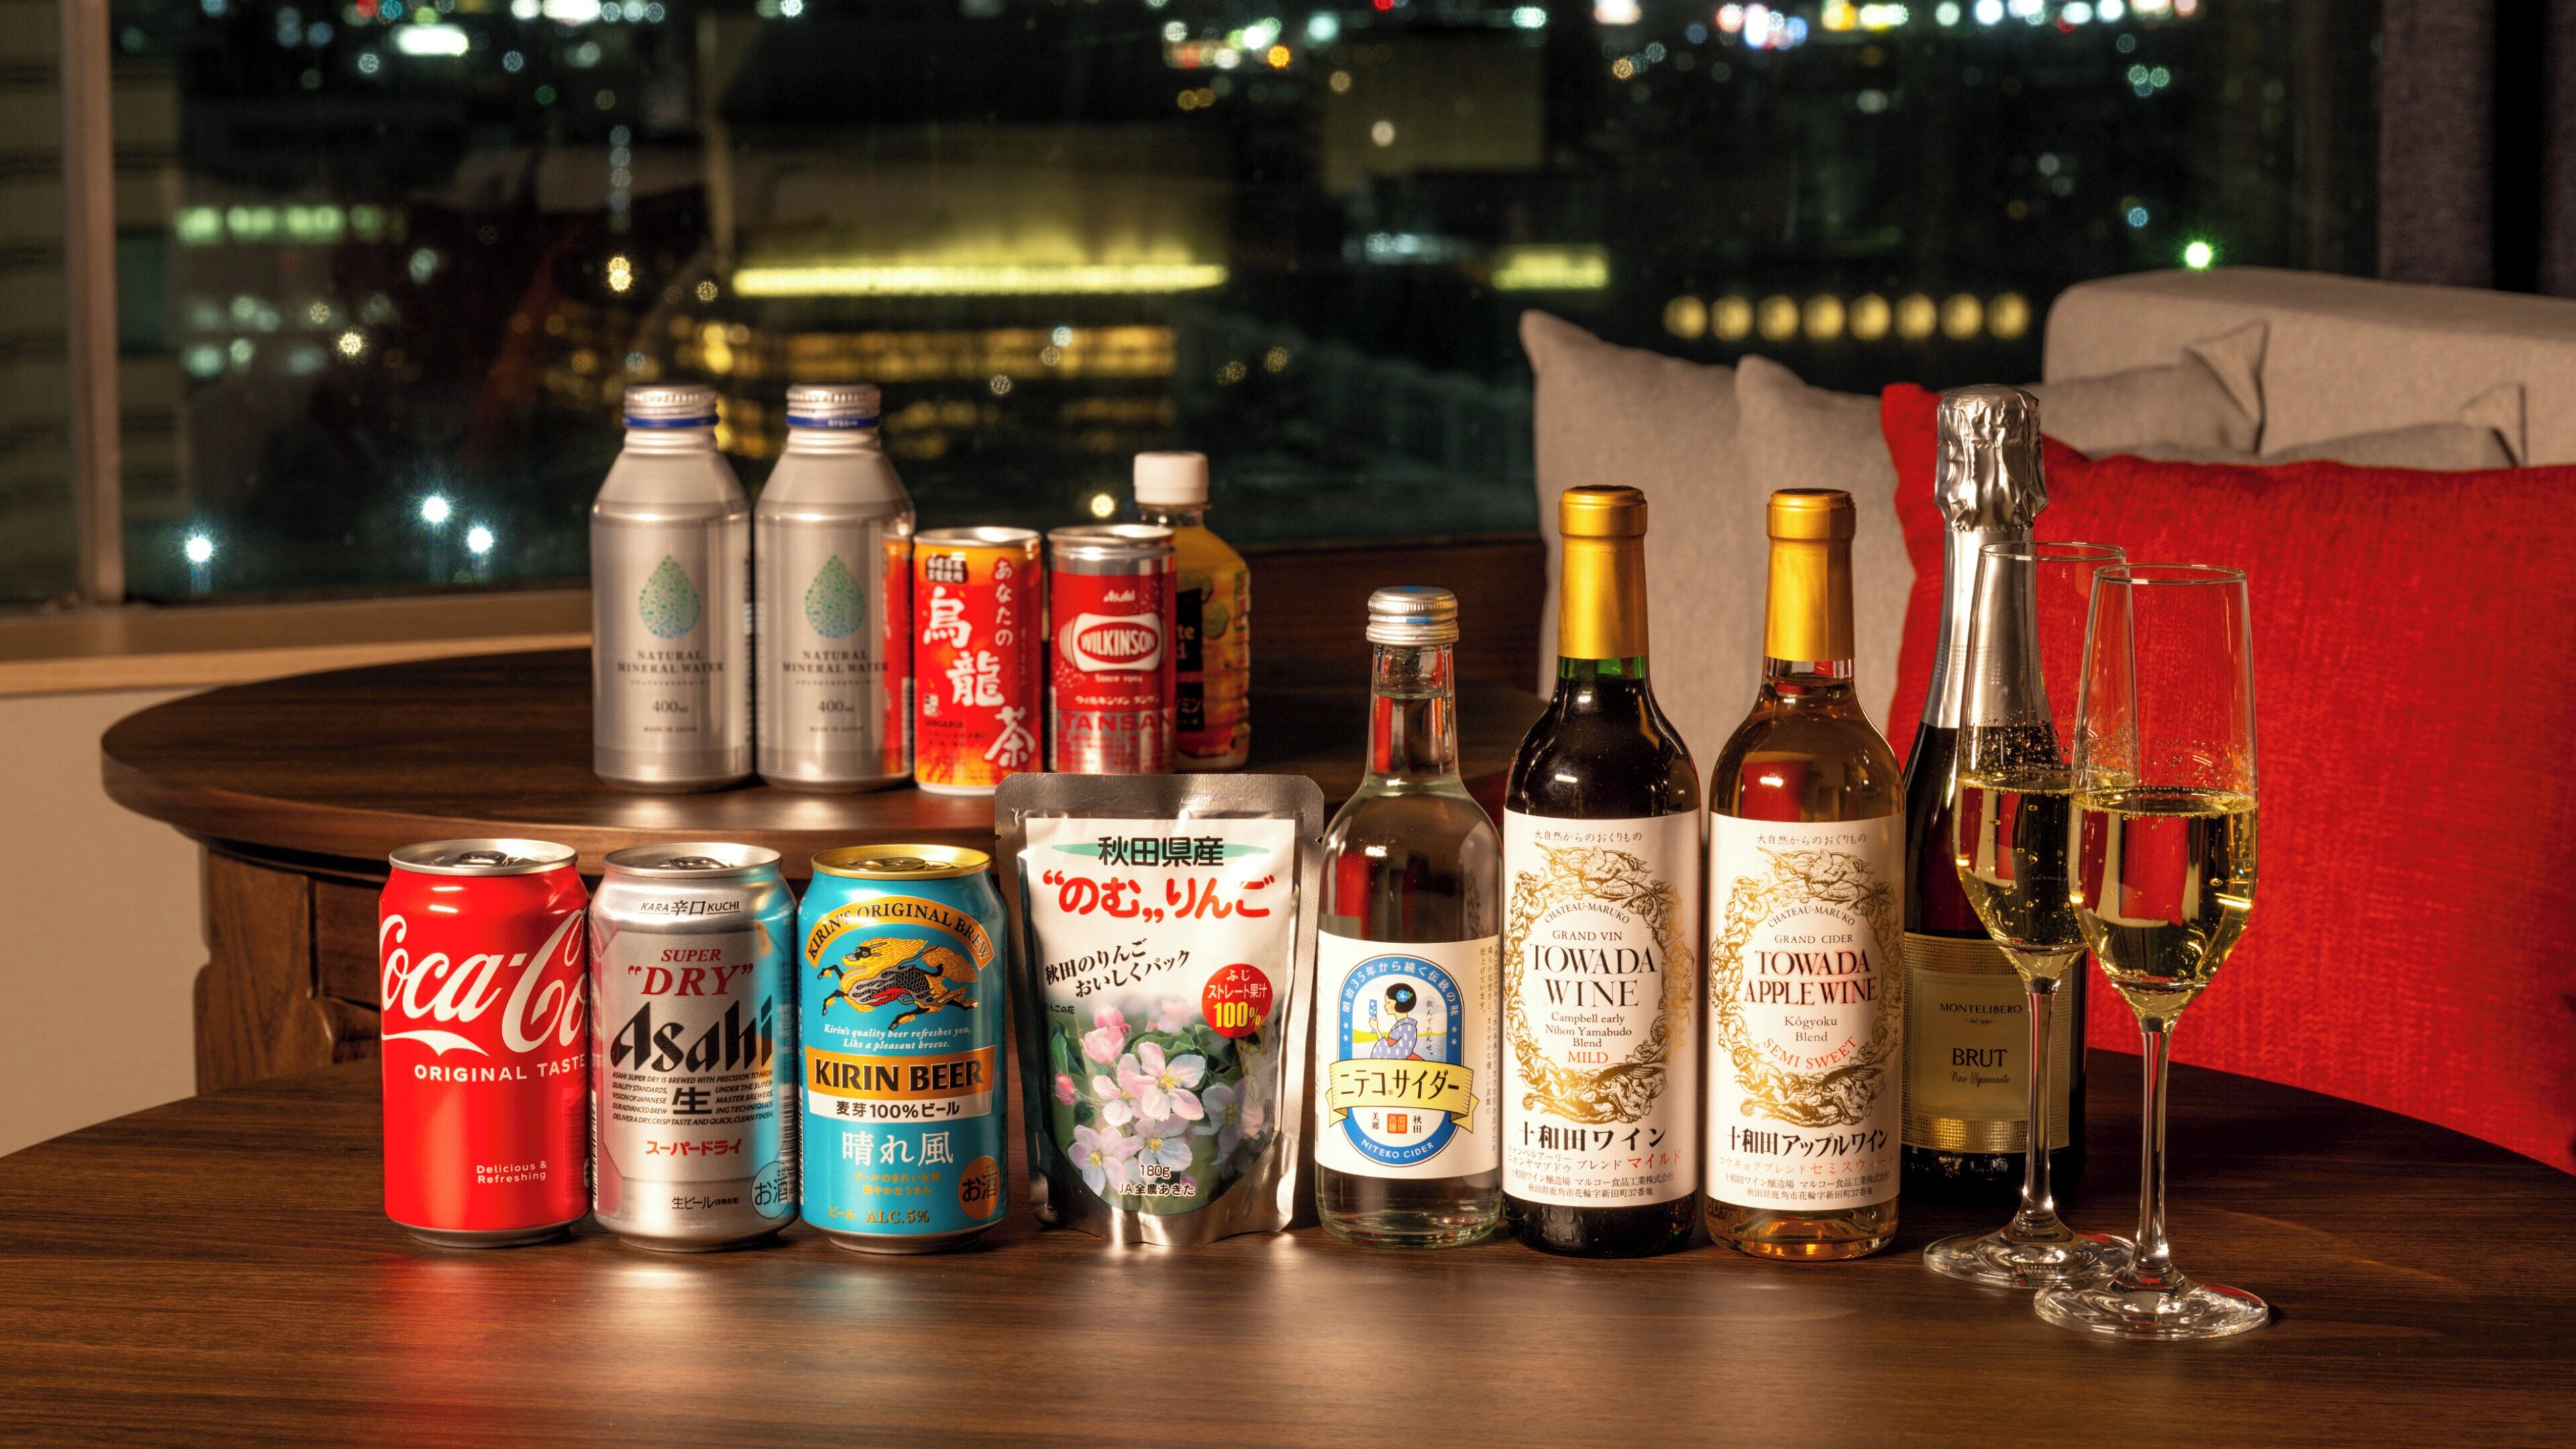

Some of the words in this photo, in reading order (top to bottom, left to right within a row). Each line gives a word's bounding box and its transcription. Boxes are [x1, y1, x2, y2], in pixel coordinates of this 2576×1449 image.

[994, 559, 1014, 647] あなたの
[1103, 590, 1136, 602] Asahi
[1079, 628, 1156, 657] WILKINSON
[638, 650, 702, 661] NATURAL
[803, 650, 869, 661] NATURAL
[618, 661, 678, 673] MINERAL
[682, 661, 724, 672] WATER
[782, 661, 843, 673] MINERAL
[847, 661, 889, 672] WATER
[923, 586, 1036, 767] 烏龍茶
[1534, 830, 1643, 843] 大自然からのおくりもの
[1756, 833, 1867, 845] 大自然からのおくりもの
[1097, 836, 1224, 867] 秋田県産
[640, 902, 669, 913] KARA
[671, 900, 706, 916] 辛口
[707, 901, 739, 912] KUCHI
[1544, 902, 1630, 924] CHATEAU-MARUKO
[1768, 906, 1856, 928] CHATEAU-MARUKO
[857, 902, 953, 926] ORIGINAL
[953, 919, 991, 959] BREW
[1552, 930, 1597, 941] GRAND
[1600, 931, 1623, 941] VIN
[1774, 934, 1815, 945] GRAND
[1821, 934, 1854, 944] CIDER
[661, 949, 722, 962] SUPER
[1044, 938, 1147, 986] 秋田のりんご
[1529, 943, 1658, 975] TOWADA
[1755, 949, 1872, 976] TOWADA
[380, 909, 588, 1053] Coca-Co
[1075, 950, 1191, 998] おいしくパック
[1226, 969, 1251, 981] ふじ
[1208, 983, 1268, 1000] ストレート果汁
[1543, 977, 1640, 1008] WINE
[1744, 980, 1815, 1006] APPLE
[1819, 977, 1878, 1005] WINE
[1213, 1002, 1261, 1028] 100%
[1939, 1002, 2023, 1014] MONTELIBERO
[1552, 1012, 1598, 1025] Campbell
[1601, 1014, 1625, 1025] early
[1784, 1016, 1837, 1029] Kôgyoku
[610, 995, 773, 1072] Asahi
[851, 1028, 886, 1040] quality
[888, 1030, 908, 1038] beer
[911, 1026, 951, 1040] refreshes
[1546, 1024, 1575, 1036] Nihon
[1578, 1026, 1632, 1037] Yamabudo
[1795, 1032, 1828, 1042] Blend
[843, 1038, 863, 1048] Like
[873, 1040, 915, 1051] pleasant
[918, 1039, 950, 1049] breeze.
[1572, 1038, 1602, 1048] Blend
[1568, 1051, 1609, 1064] MILD
[1764, 1038, 1799, 1068] SEMI
[1806, 1036, 1857, 1069] SWEET
[1952, 1048, 2008, 1067] BRUT
[415, 1064, 527, 1082] ORIGINAL
[537, 1053, 586, 1077] TASTE
[815, 1058, 899, 1091] KIRIN
[909, 1059, 983, 1091] BEER
[628, 1073, 646, 1081] SUPER
[716, 1073, 749, 1083] PRECISION
[759, 1069, 773, 1077] HIGH
[1950, 1071, 1968, 1083] Vino
[1970, 1071, 2010, 1087] Spumante
[612, 1081, 633, 1090] QUALITY
[715, 1084, 741, 1093] UNDER
[612, 1091, 629, 1101] VISION
[637, 1095, 667, 1104] JAPANESE
[715, 1095, 745, 1104] MASTER
[672, 1087, 712, 1114] 生
[623, 1104, 649, 1113] ADVANCED
[731, 1101, 773, 1112] TECHNIQUES
[837, 1100, 960, 1119] 麦芽100%ビール
[613, 1113, 633, 1122] DELIVER
[733, 1115, 755, 1123] CLEAN
[1413, 1114, 1422, 1133] 秋田
[1519, 1121, 1667, 1152] 十和田ワイン
[1727, 1126, 1888, 1158] 十和田アップルワイン
[645, 1138, 742, 1157] スーパードライ
[842, 1130, 954, 1167] 晴れ風
[1361, 1139, 1400, 1159] NITEKO
[1403, 1142, 1435, 1158] CIDER
[476, 1163, 535, 1174] Delicious
[540, 1161, 547, 1169] &
[1577, 1159, 1621, 1170] ブレンド
[1627, 1149, 1681, 1169] マイルド
[478, 1172, 546, 1184] Refreshing
[1140, 1164, 1171, 1179] 180g
[1575, 1171, 1674, 1187] マルコー食品工業株式会社
[754, 1176, 788, 1206] お酒
[961, 1172, 998, 1202] お酒
[1118, 1183, 1196, 1196] JA全農あきた
[1528, 1183, 1653, 1198] 秋田県鹿角市花輪字新田町37番地
[828, 1206, 855, 1220] ビール
